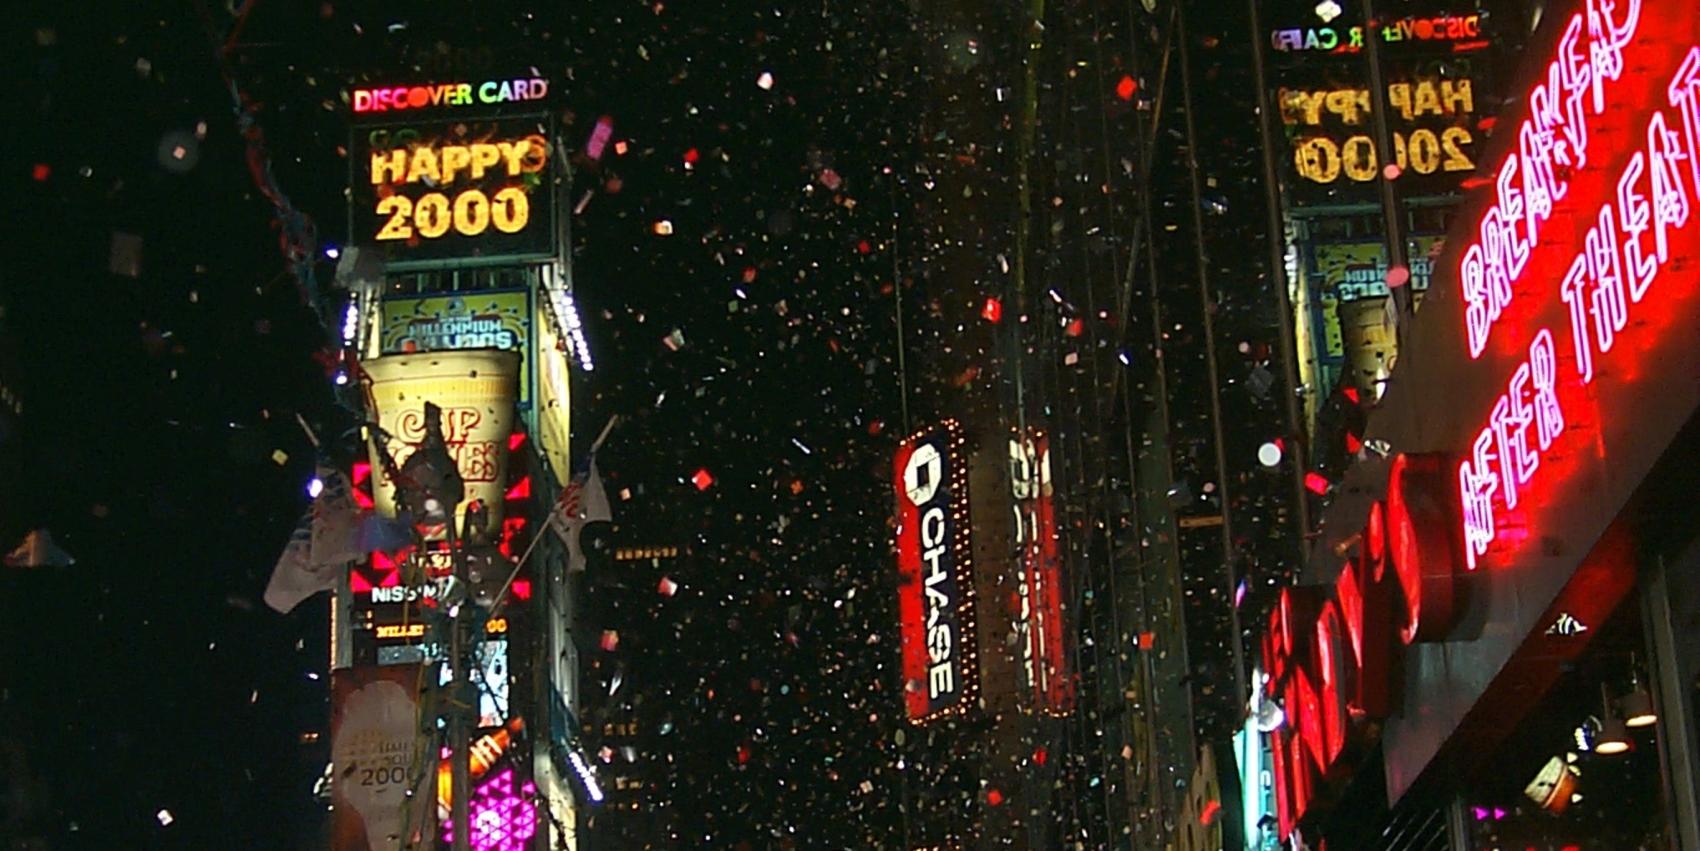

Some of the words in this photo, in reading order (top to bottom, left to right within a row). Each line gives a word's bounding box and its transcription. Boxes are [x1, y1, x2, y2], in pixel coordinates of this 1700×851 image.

[354, 83, 473, 112] DISCOVER
[478, 78, 547, 104] CARD
[371, 139, 531, 185] HAPPY
[375, 186, 529, 241] 2000
[1460, 328, 1564, 570] AFTER
[920, 506, 954, 699] CHASE
